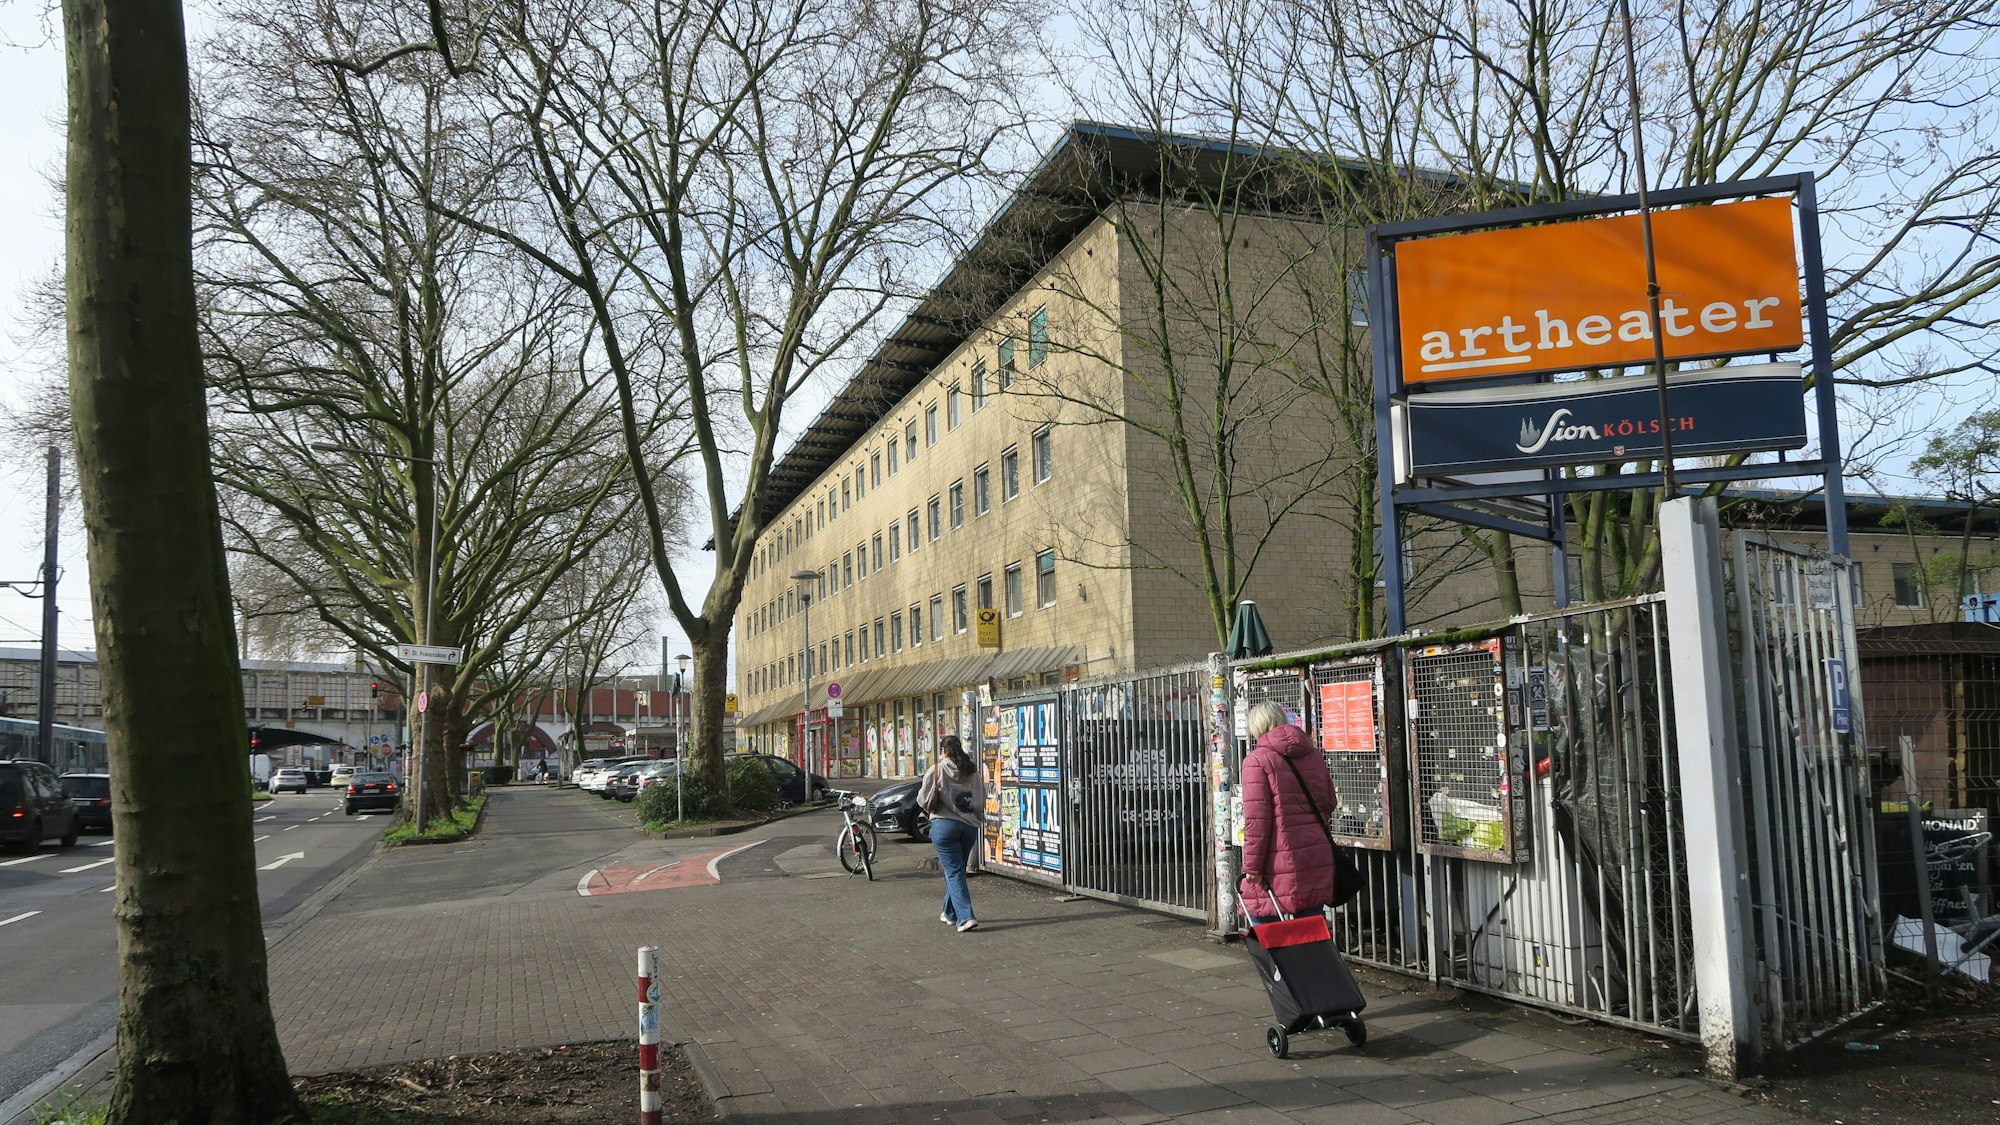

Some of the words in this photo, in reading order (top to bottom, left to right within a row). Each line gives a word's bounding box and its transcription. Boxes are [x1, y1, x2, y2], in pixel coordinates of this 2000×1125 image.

[1420, 296, 1780, 362] artheater
[1516, 408, 1601, 454] Sion
[1832, 664, 1844, 705] P
[1018, 705, 1037, 746] EXL
[1038, 703, 1058, 746] EXL
[1020, 787, 1040, 830] EXL
[1040, 788, 1060, 832] EXL
